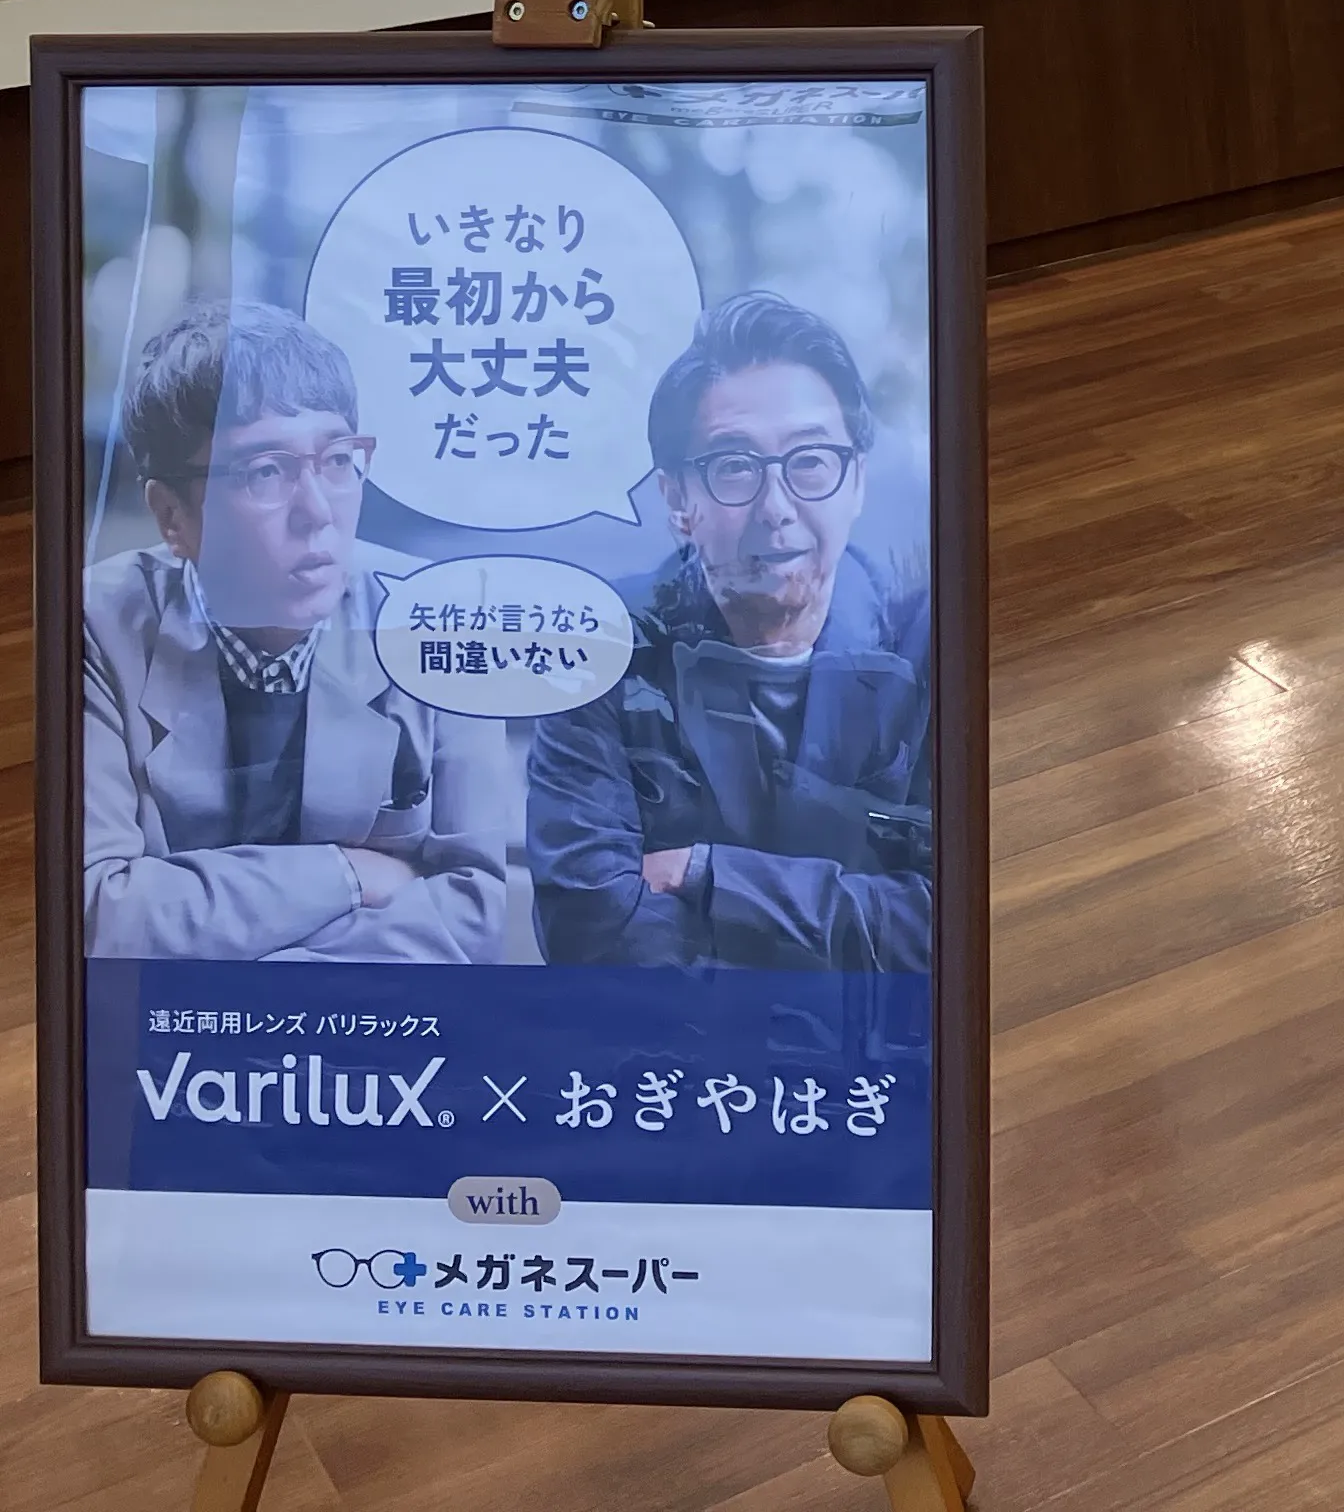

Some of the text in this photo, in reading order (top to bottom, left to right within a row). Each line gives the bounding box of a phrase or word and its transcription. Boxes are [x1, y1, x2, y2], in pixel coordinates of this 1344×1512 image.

[407, 203, 586, 254] いきなり
[383, 266, 616, 327] 最初から
[408, 338, 591, 399] 大丈夫
[433, 412, 571, 461] だった
[409, 602, 599, 634] 矢作が言うなら
[420, 640, 588, 675] 間違いない
[148, 1008, 442, 1038] 遠近両用レンズ バリラックス
[555, 1068, 897, 1140] おぎやはぎ
[467, 1185, 541, 1218] with
[433, 1252, 700, 1296] メガネスーパー
[378, 1300, 641, 1322] EYE CARE STATION
